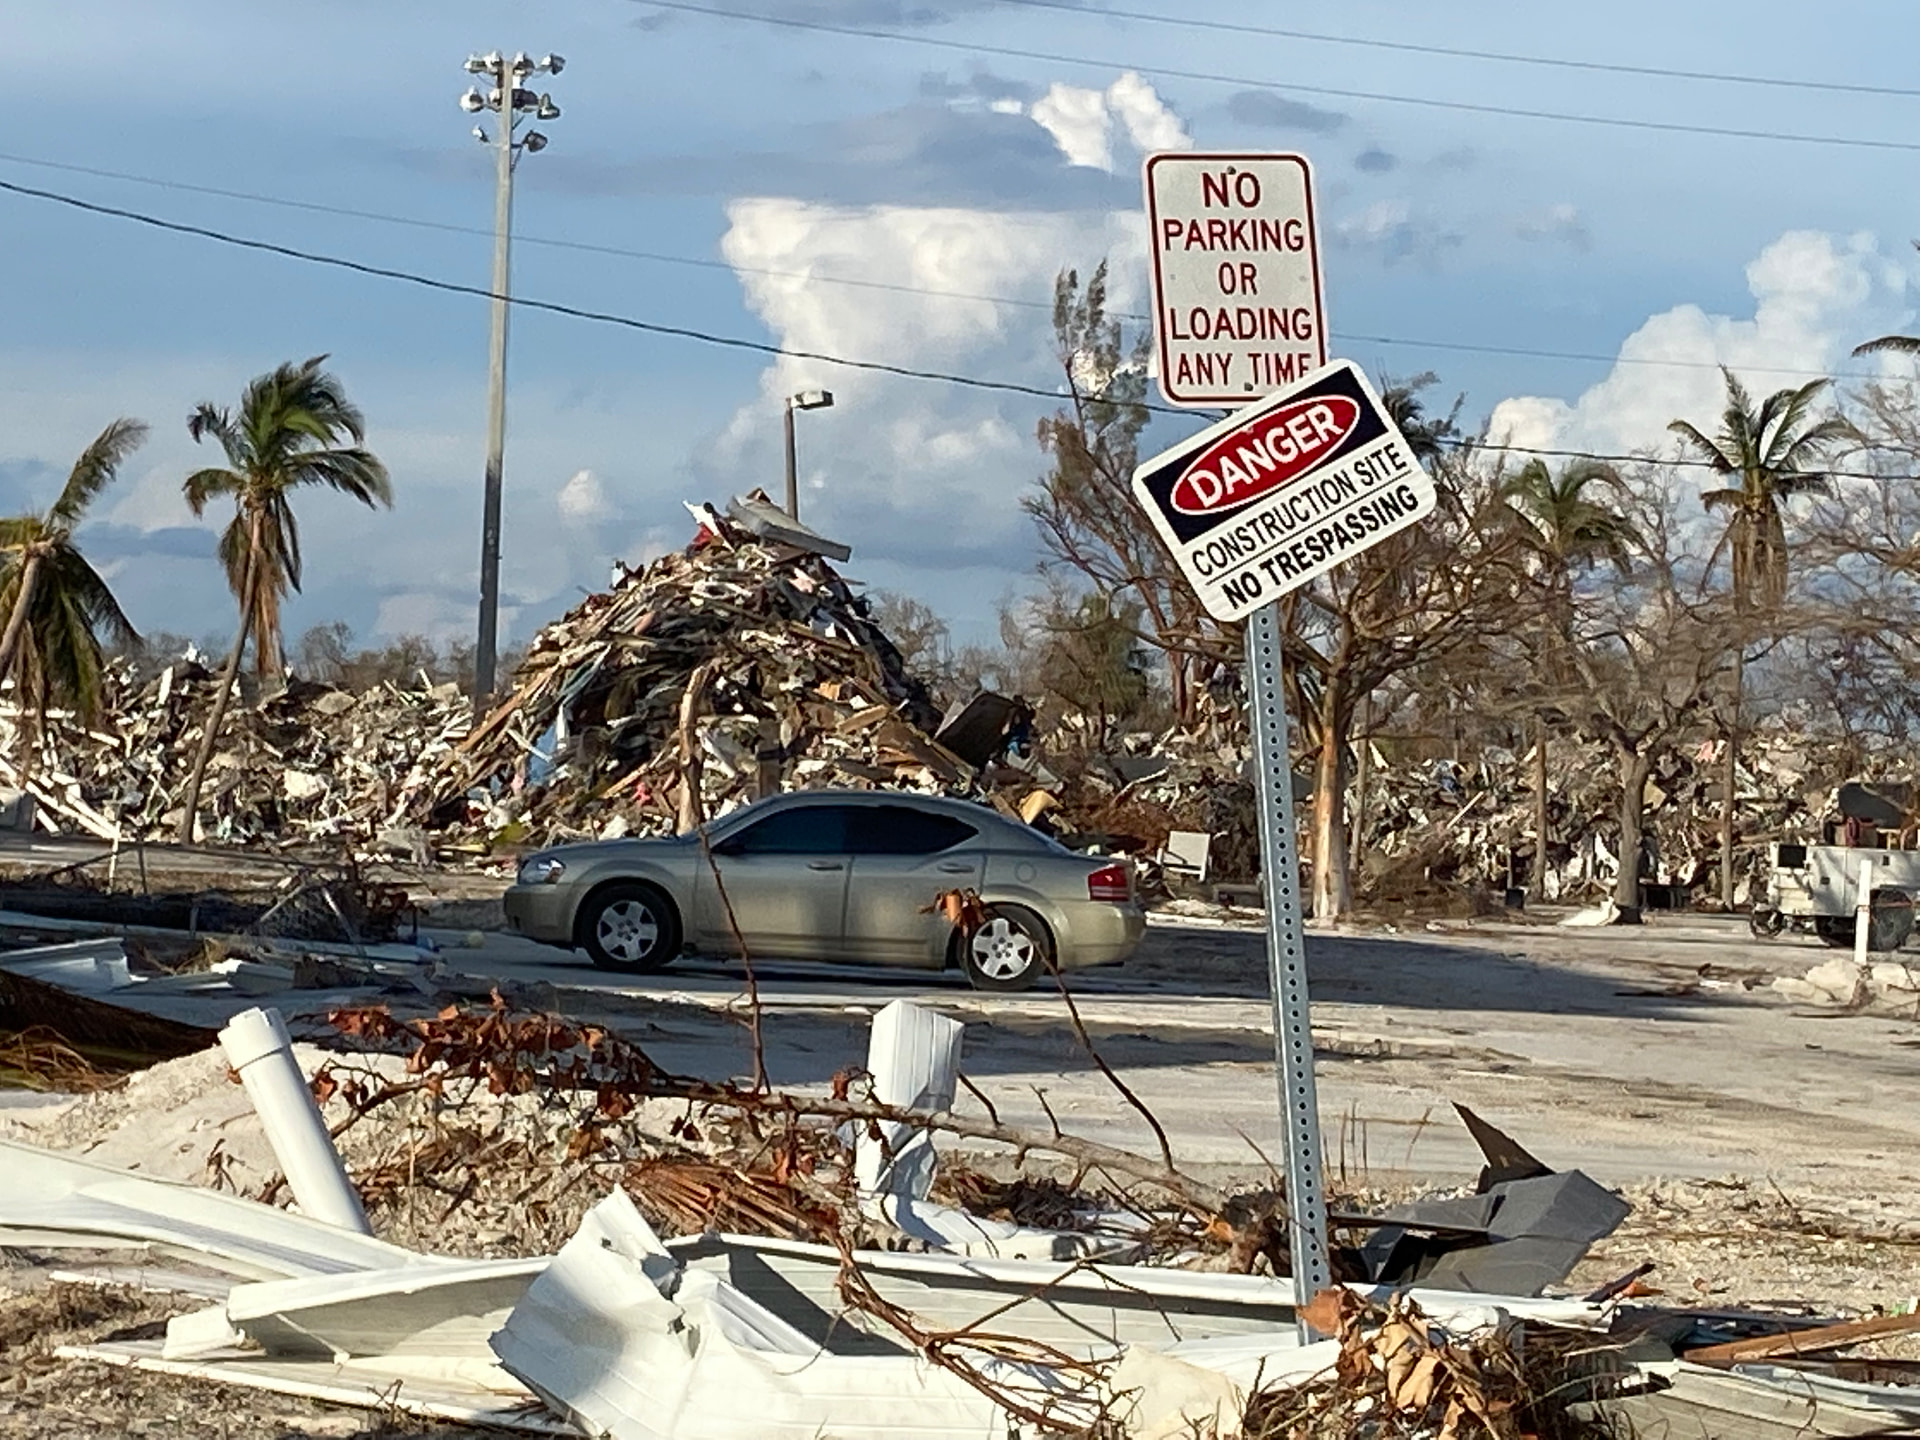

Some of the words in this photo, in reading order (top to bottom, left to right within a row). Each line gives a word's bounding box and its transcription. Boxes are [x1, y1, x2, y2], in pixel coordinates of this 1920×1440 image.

[1201, 172, 1261, 208] NO
[1162, 219, 1304, 252] PARKING
[1218, 262, 1258, 295] OR
[1170, 307, 1312, 341] LOADING
[1176, 353, 1233, 386] ANY
[1187, 404, 1344, 508] DANGER
[1192, 469, 1358, 577] CONSTRUCTION
[1354, 443, 1407, 487] SITE
[1222, 571, 1262, 610] NO
[1260, 485, 1419, 587] TRESPASSING
